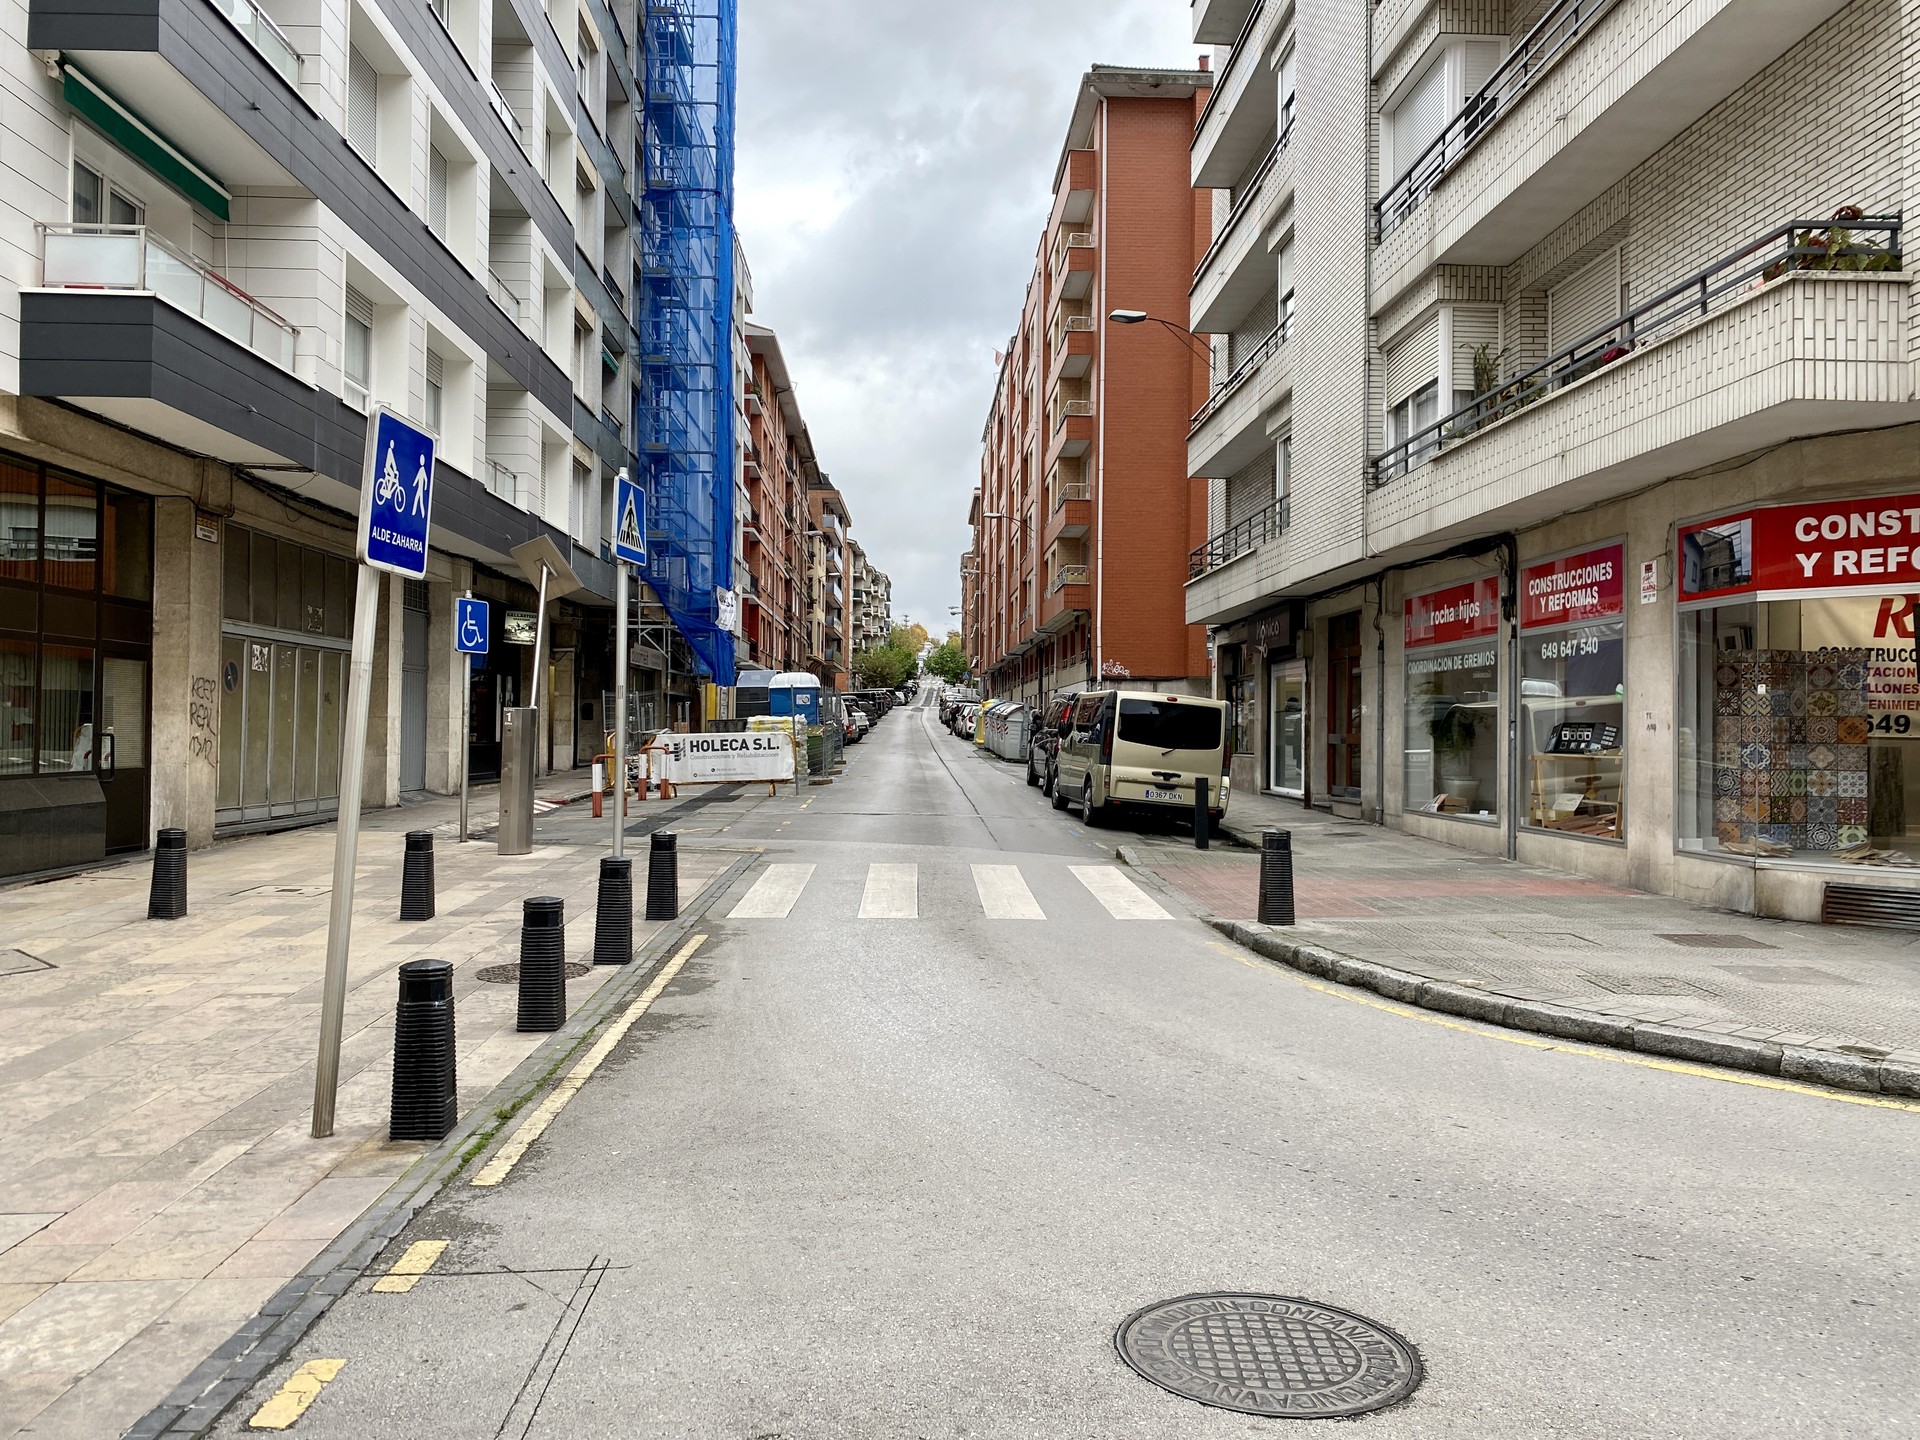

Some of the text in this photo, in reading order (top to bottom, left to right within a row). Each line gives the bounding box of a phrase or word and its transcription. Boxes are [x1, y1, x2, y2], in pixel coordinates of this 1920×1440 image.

[1795, 508, 1920, 543] CONST
[371, 525, 423, 554] ALDE ZAHARRA
[1795, 551, 1822, 577] Y
[1528, 561, 1613, 596] CONSTRUCCIONES
[1540, 597, 1548, 613] Y
[1548, 586, 1599, 612] REFORMAS
[1541, 637, 1598, 660] 649 647 540
[1408, 656, 1452, 675] COORDINACION
[1453, 655, 1463, 669] DE
[1463, 650, 1495, 669] GREMIOS
[191, 675, 216, 704] KEEP
[506, 712, 512, 722] 1
[689, 737, 780, 753] HOLECA S.L.
[689, 753, 731, 761] Construcciones
[1150, 790, 1183, 800] 0367 DKN
